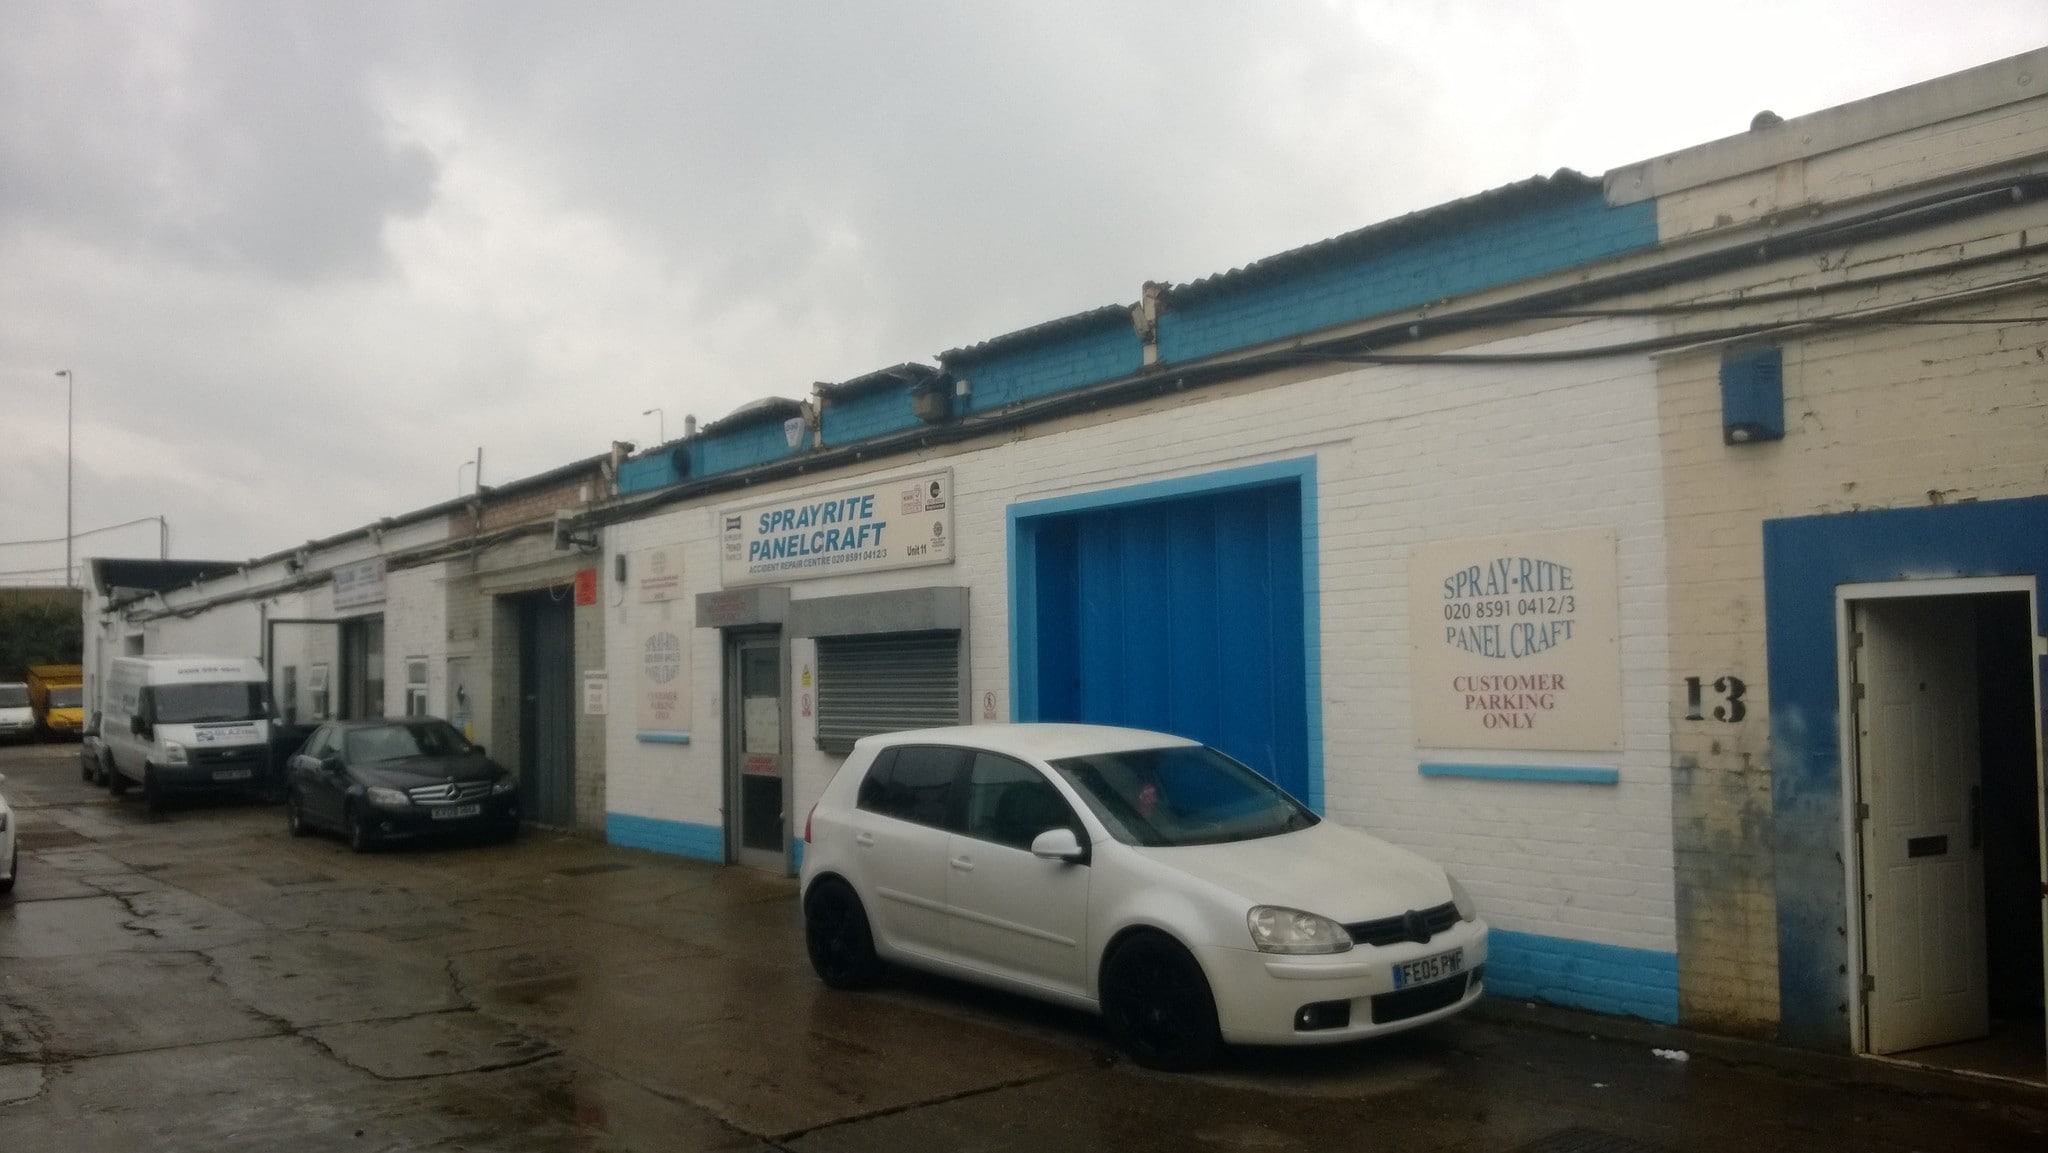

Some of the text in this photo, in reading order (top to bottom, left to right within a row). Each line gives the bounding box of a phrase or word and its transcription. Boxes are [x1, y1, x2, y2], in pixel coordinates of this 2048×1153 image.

[758, 494, 875, 535] SPRAYRITE
[749, 522, 887, 561] PANELCRAFT
[907, 545, 920, 556] Unit
[920, 544, 927, 555] 11
[749, 563, 779, 573] ACCIDENT
[780, 560, 803, 570] REPAIR
[804, 556, 830, 568] CENTRE
[832, 555, 844, 564] 020
[845, 552, 862, 563] 8591
[1444, 557, 1574, 600] SPRAY-RITE
[1444, 595, 1575, 620] 020 8591 0412/3
[1446, 620, 1575, 659] PANEL CRAFT
[1453, 673, 1565, 693] CUSTOMER
[1465, 694, 1554, 711] PARKING
[1684, 676, 1746, 723] 13
[1483, 712, 1536, 729] ONLY
[1403, 958, 1438, 984] FE05
